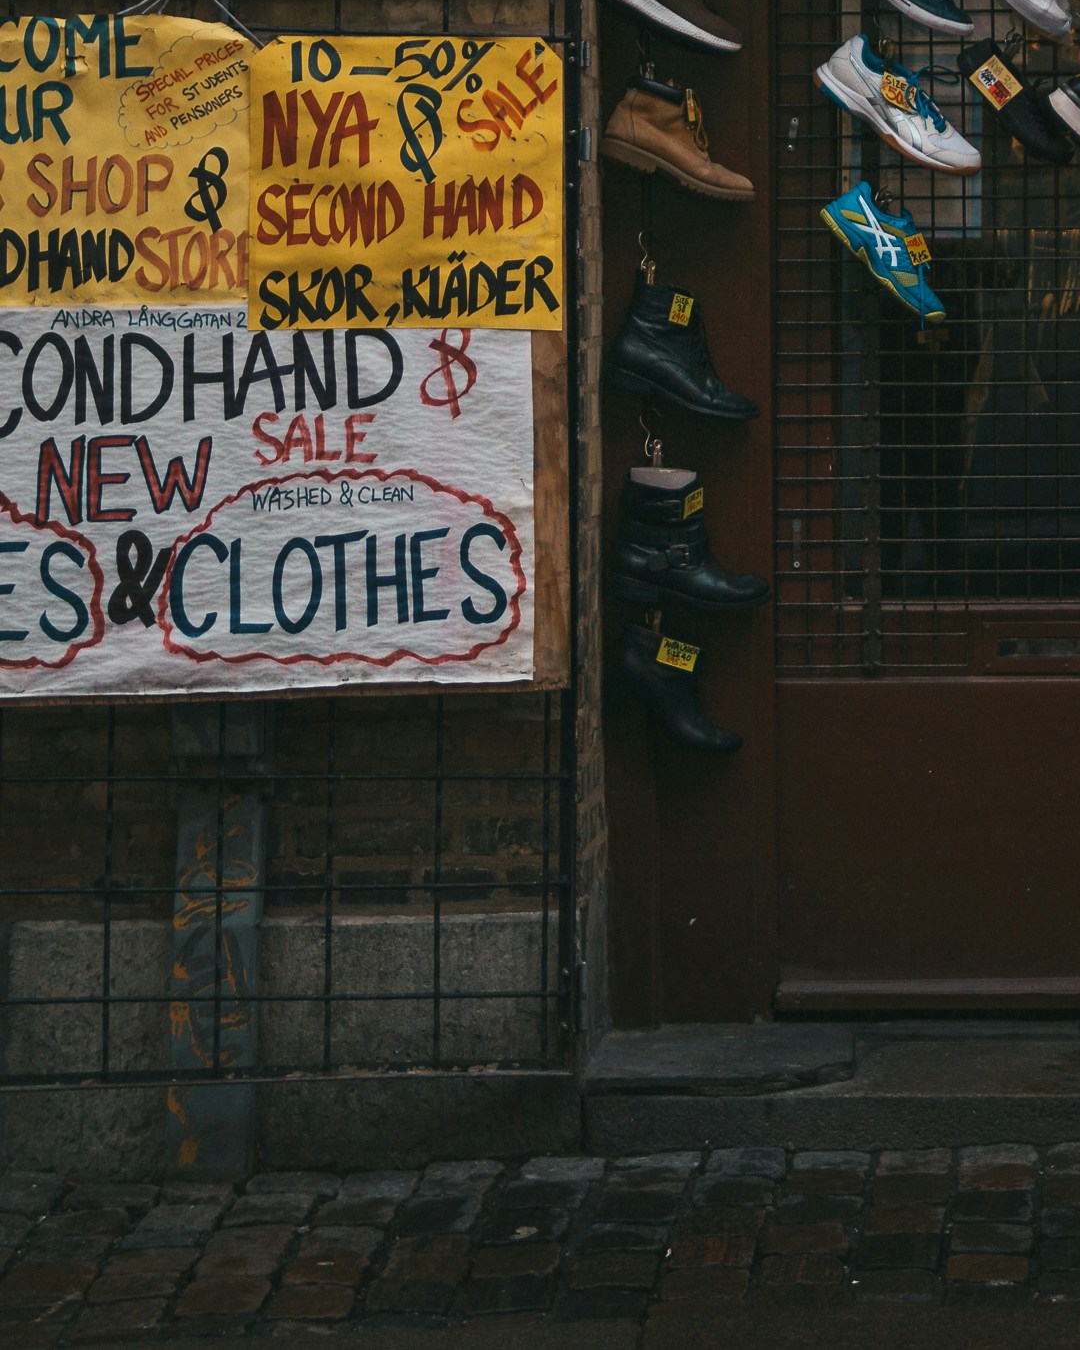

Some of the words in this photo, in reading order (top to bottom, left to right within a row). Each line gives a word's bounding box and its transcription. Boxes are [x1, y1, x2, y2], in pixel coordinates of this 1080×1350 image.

[135, 68, 193, 103] SPECIAL
[194, 39, 244, 71] PRICES
[145, 97, 180, 120] FOR
[182, 60, 250, 101] STUDENTS
[456, 48, 558, 152] SALE
[886, 75, 907, 91] SIZE
[144, 125, 167, 146] AND
[170, 85, 243, 130] PENSIONERS
[262, 89, 380, 170] NYA
[26, 152, 174, 217] SHOP
[256, 180, 405, 248] SECOND
[423, 173, 544, 240] HAND
[402, 250, 560, 320] KLÄDER
[51, 309, 115, 330] ANDRA
[128, 305, 232, 331] LÅNGGATAN
[35, 434, 213, 526] NEW
[252, 411, 378, 466] SALE
[250, 486, 333, 513] WASHED
[340, 480, 354, 507] &
[358, 485, 414, 504] CLEAN
[107, 530, 175, 628] &
[169, 522, 507, 638] CLOTHES
